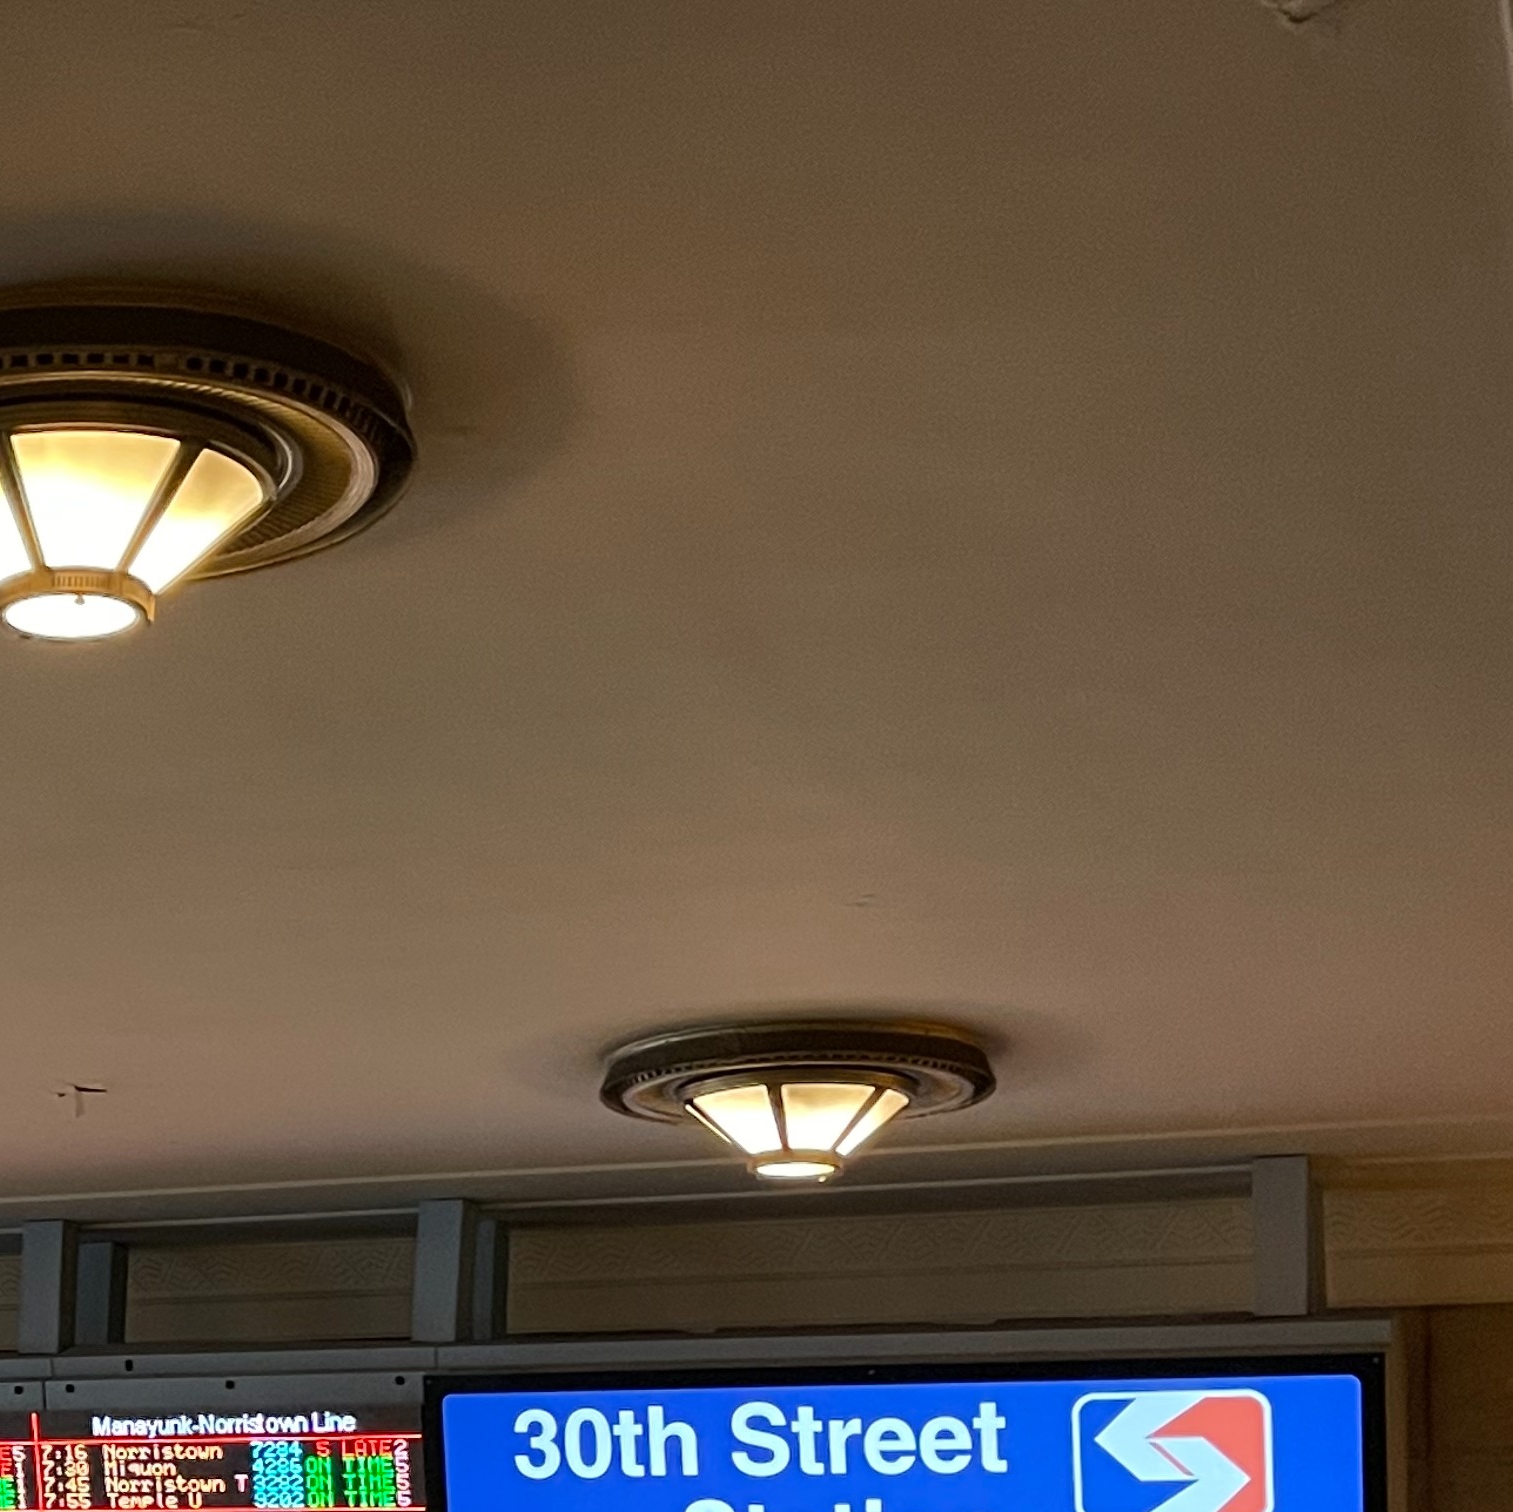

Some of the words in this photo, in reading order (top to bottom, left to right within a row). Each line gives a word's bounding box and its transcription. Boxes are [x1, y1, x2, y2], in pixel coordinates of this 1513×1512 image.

[92, 1413, 309, 1438] Manayunk-Norristown
[311, 1412, 357, 1433] Line
[41, 1445, 88, 1460] 7:16
[102, 1444, 223, 1459] Norristown
[316, 1441, 330, 1456] 5
[342, 1440, 392, 1456] LATE
[394, 1440, 407, 1454] 2
[513, 1404, 699, 1480] 30th
[730, 1401, 1008, 1478] Street
[305, 1458, 331, 1473] ON
[343, 1457, 393, 1474] TIME
[44, 1477, 90, 1492] 7:45
[105, 1476, 226, 1493] Norristown
[235, 1475, 248, 1492] T
[307, 1476, 332, 1491] ON
[344, 1474, 395, 1490] TIME
[45, 1493, 91, 1508] 7:55
[106, 1493, 179, 1509] Temple
[189, 1492, 203, 1509] U
[307, 1492, 334, 1507] ON
[345, 1491, 396, 1507] TIME
